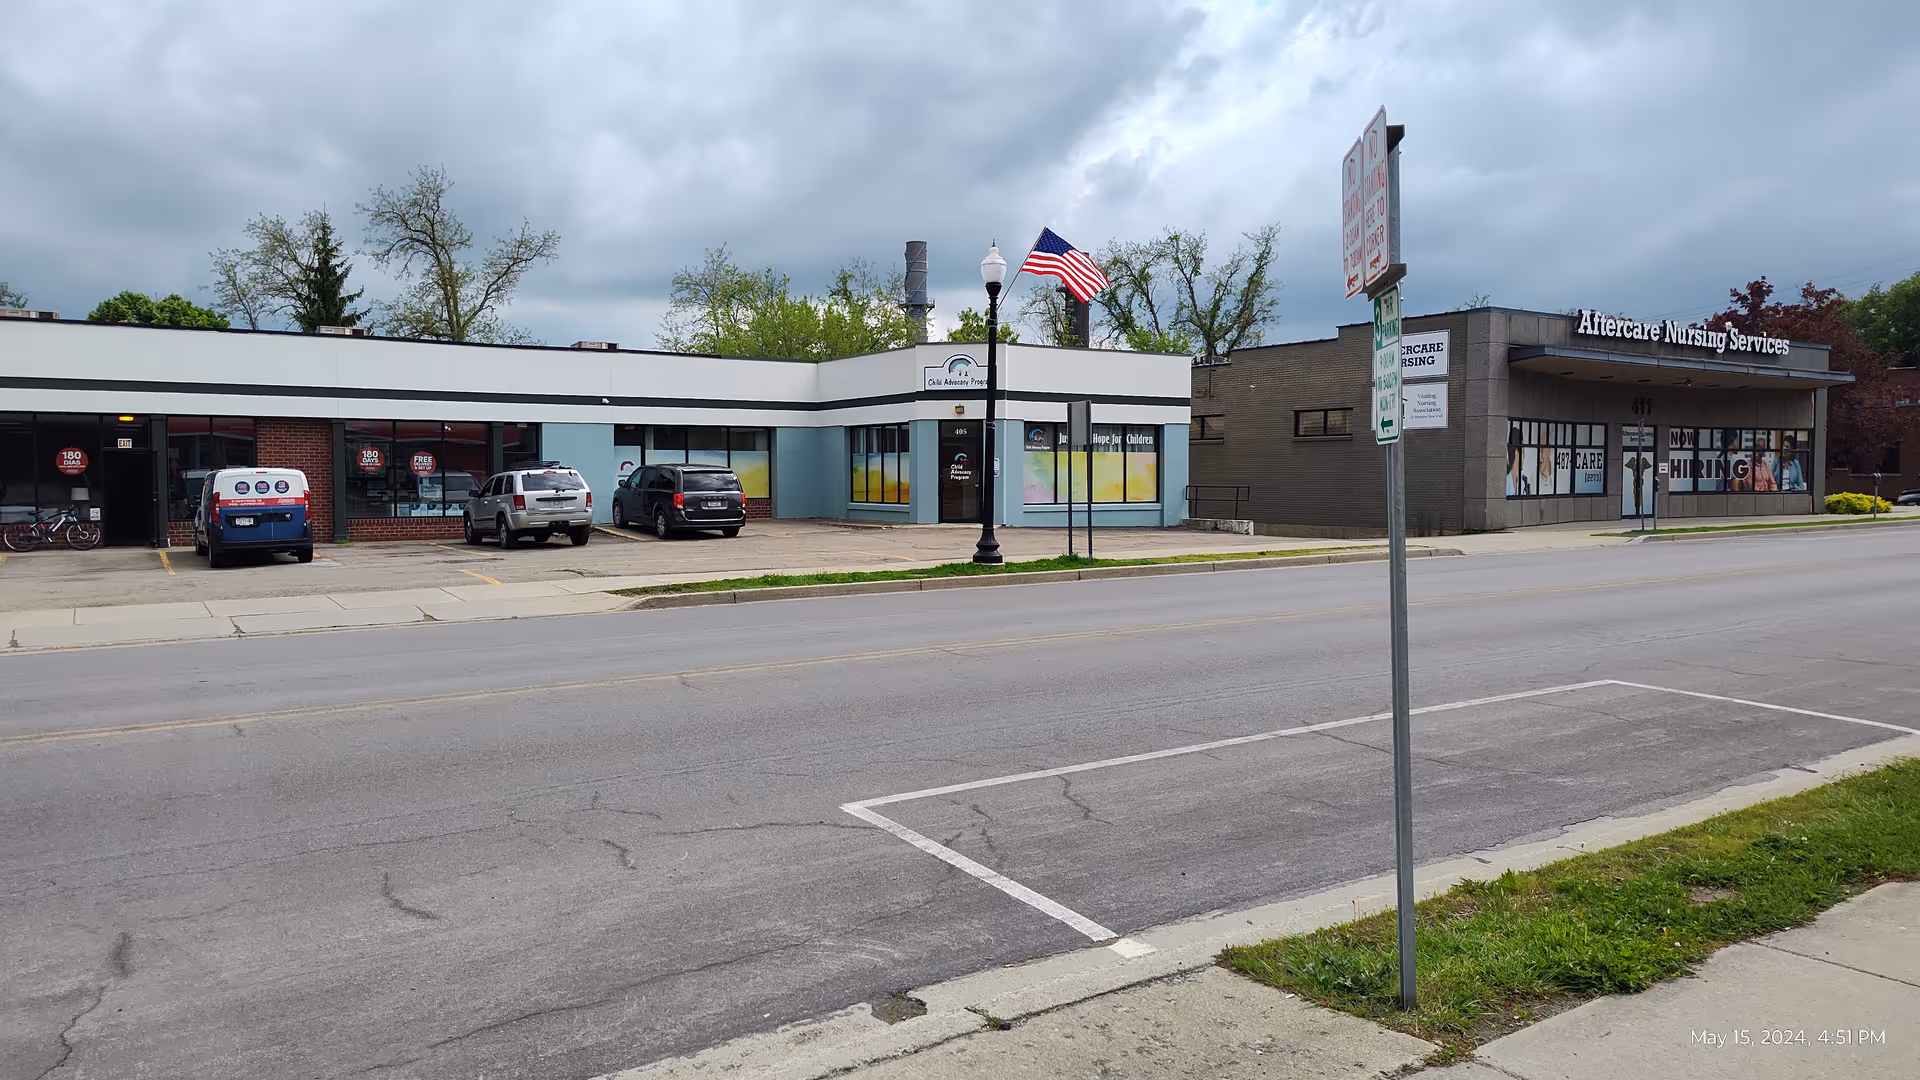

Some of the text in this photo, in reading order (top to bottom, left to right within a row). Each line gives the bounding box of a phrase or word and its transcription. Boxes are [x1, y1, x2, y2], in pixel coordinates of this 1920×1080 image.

[1369, 130, 1378, 165] NO
[1348, 158, 1356, 190] NO
[1364, 160, 1385, 206] STANDING
[1366, 196, 1385, 230] HERE TO
[1366, 224, 1385, 257] CORNER
[1385, 296, 1394, 315] HR
[1375, 305, 1382, 342] 3
[1382, 317, 1399, 339] PARKING
[1578, 309, 1790, 355] Aftercare Nursing Services
[1402, 342, 1444, 355] ERCARE
[1402, 356, 1436, 368] RSING
[928, 377, 988, 386] Child Advocacy Progra
[1377, 376, 1383, 393] TO
[1093, 433, 1110, 445] Hope
[1112, 433, 1122, 445] for
[1126, 433, 1154, 445] Children
[62, 451, 81, 460] 180
[362, 450, 379, 458] 180
[1670, 458, 1750, 480] HIRING
